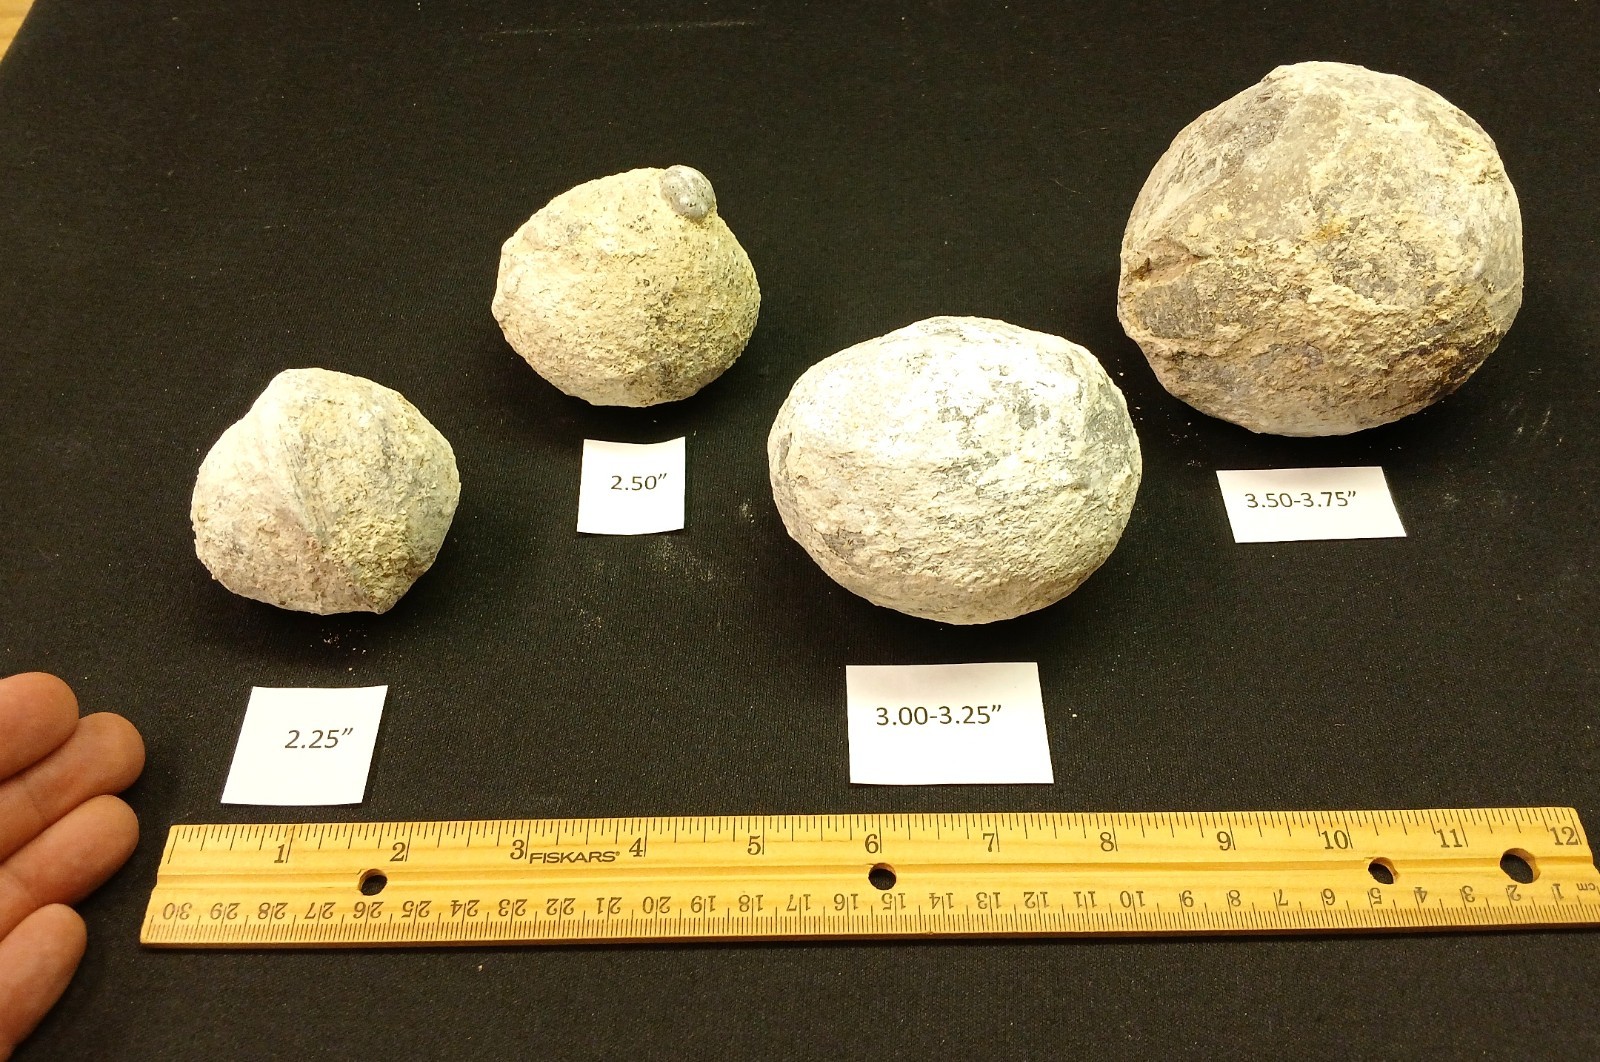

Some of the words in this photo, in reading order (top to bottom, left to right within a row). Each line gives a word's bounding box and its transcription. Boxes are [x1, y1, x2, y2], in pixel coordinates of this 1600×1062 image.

[274, 844, 286, 863] 1
[390, 843, 406, 862] 2
[510, 839, 526, 860] 3
[629, 837, 644, 857] 4
[747, 835, 762, 855] 5
[864, 834, 879, 854] 6
[982, 833, 996, 852] 7
[1100, 832, 1115, 851] 8
[1217, 831, 1232, 850] 9
[1321, 830, 1349, 850] 10
[1436, 828, 1463, 848] 11
[1550, 827, 1579, 846] 12
[929, 892, 955, 909] 14
[976, 892, 1001, 909] 13
[1023, 892, 1049, 909] 12
[1073, 891, 1096, 908] 11
[1120, 890, 1145, 908] 10
[1182, 890, 1194, 908] 9
[1229, 889, 1242, 907] 8
[1276, 889, 1289, 907] 7
[1324, 888, 1336, 905] 6
[1370, 888, 1382, 905] 5
[1415, 887, 1428, 904] 4
[1461, 885, 1475, 903] 3
[1507, 885, 1522, 902] 2
[1553, 883, 1565, 900] 1
[210, 902, 240, 919] 29
[258, 902, 286, 919] 28
[305, 902, 336, 919] 27
[353, 901, 383, 919] 26
[401, 900, 432, 918] 25
[451, 900, 479, 917] 24
[499, 899, 527, 917] 23
[546, 898, 575, 916] 22
[596, 897, 622, 915] 21
[642, 896, 671, 914] 20
[691, 895, 717, 913] 19
[739, 894, 764, 912] 18
[786, 894, 811, 912] 17
[834, 893, 859, 911] 16
[881, 893, 907, 910] 15
[163, 902, 193, 920] 30
